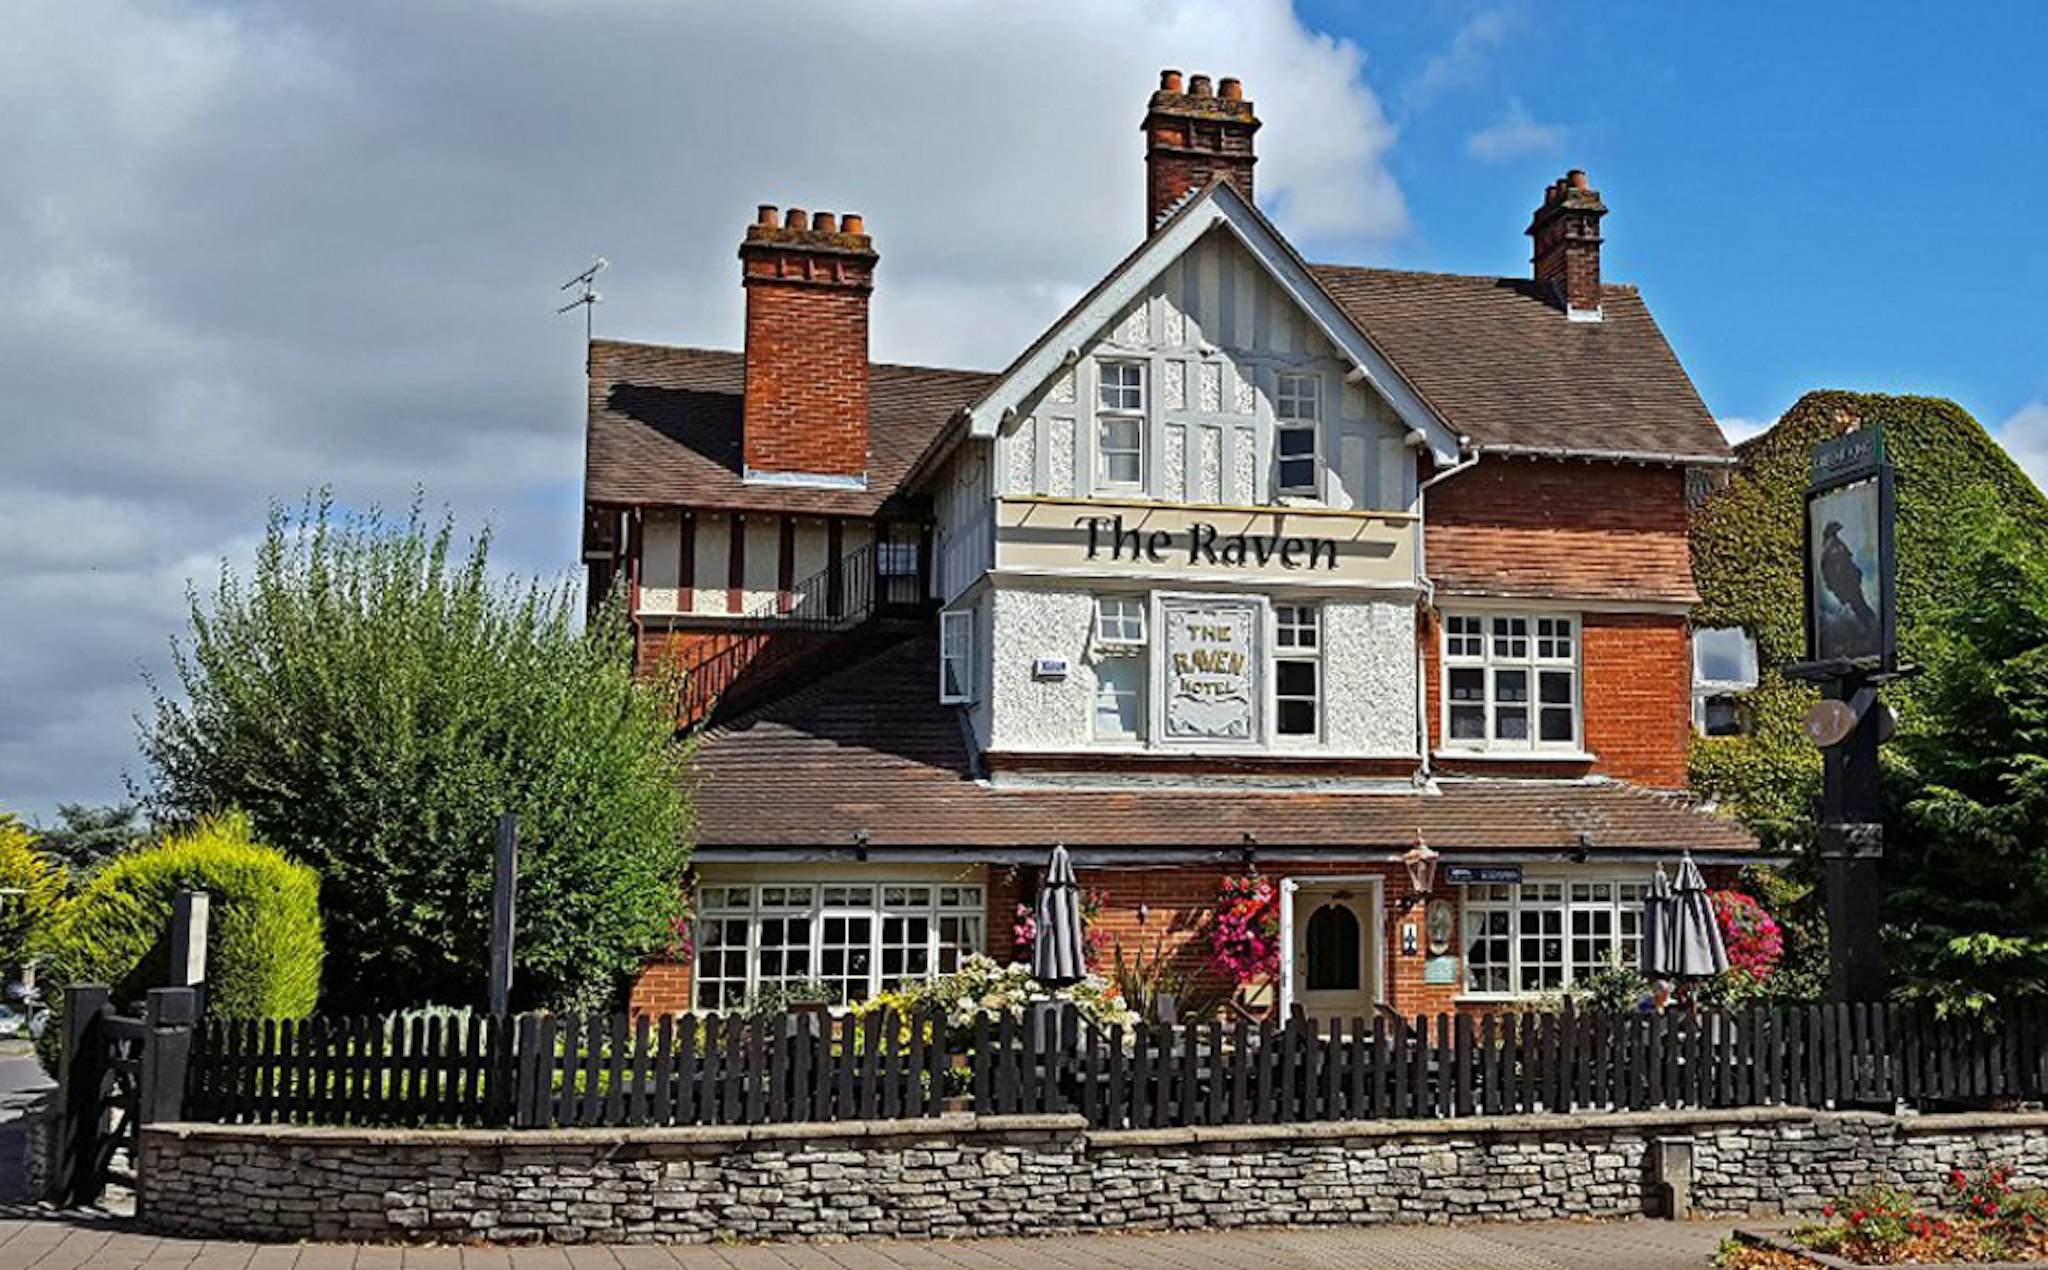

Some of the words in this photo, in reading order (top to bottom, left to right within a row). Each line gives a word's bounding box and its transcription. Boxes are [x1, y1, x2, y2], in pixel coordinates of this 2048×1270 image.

[1075, 514, 1171, 564] The
[1187, 521, 1341, 571] Raven
[1186, 624, 1232, 642] THE
[1173, 649, 1245, 676] RAVEN
[1181, 678, 1238, 695] HOTEL
